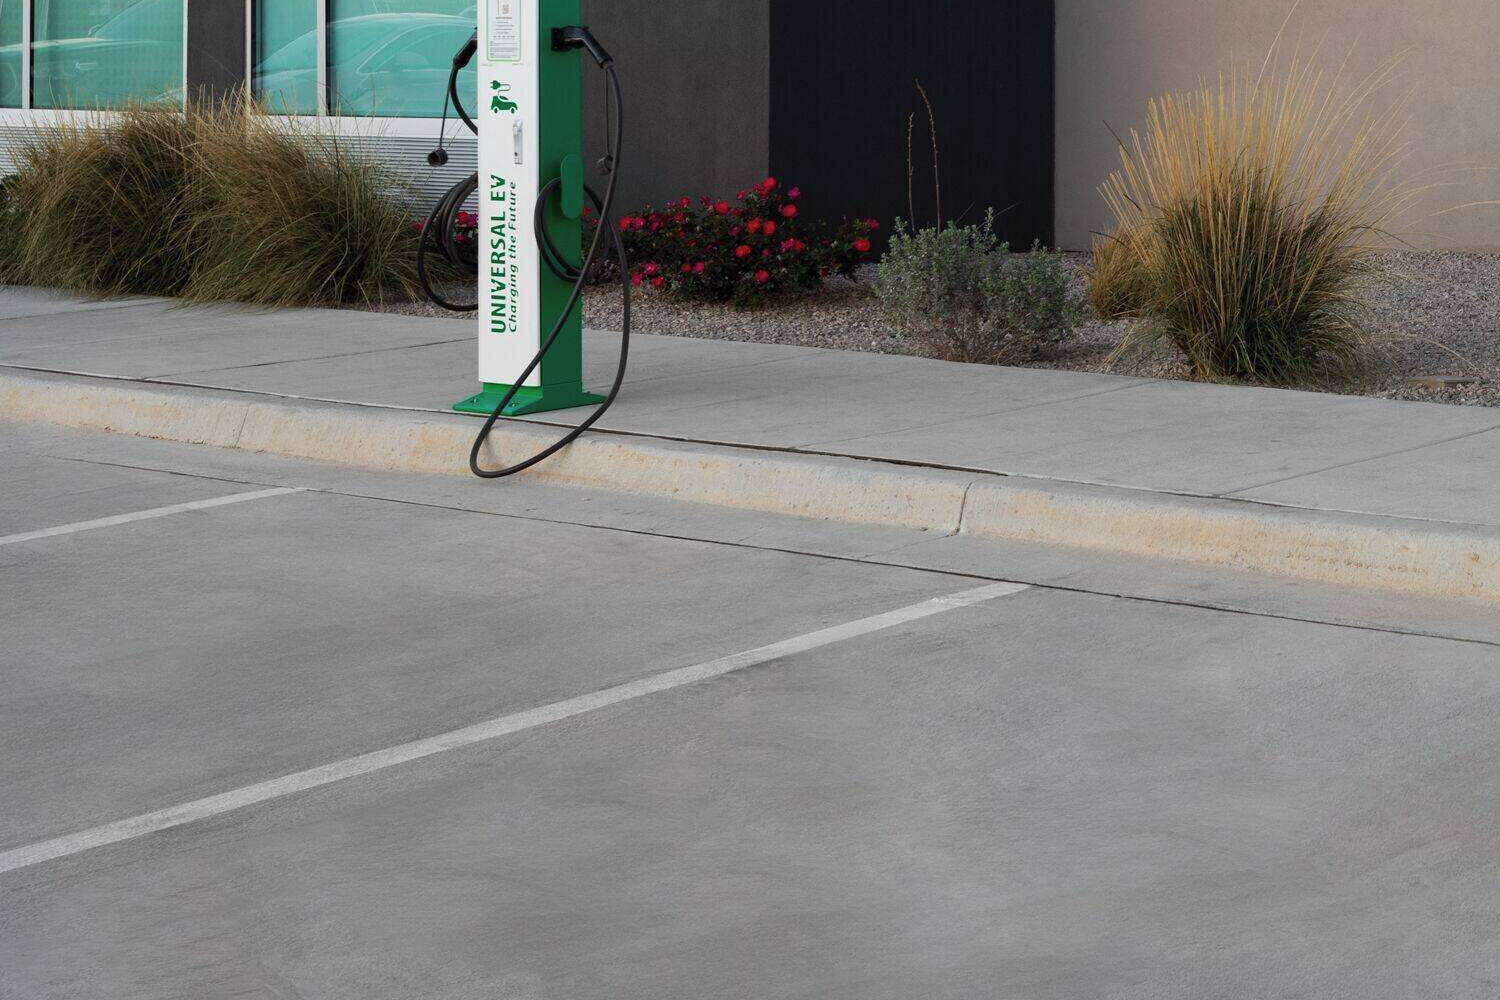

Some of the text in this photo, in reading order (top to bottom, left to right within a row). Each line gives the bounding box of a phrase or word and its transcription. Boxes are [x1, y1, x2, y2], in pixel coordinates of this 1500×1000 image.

[490, 174, 506, 333] UNIVERSAL EV
[508, 181, 519, 332] Charging the Future
